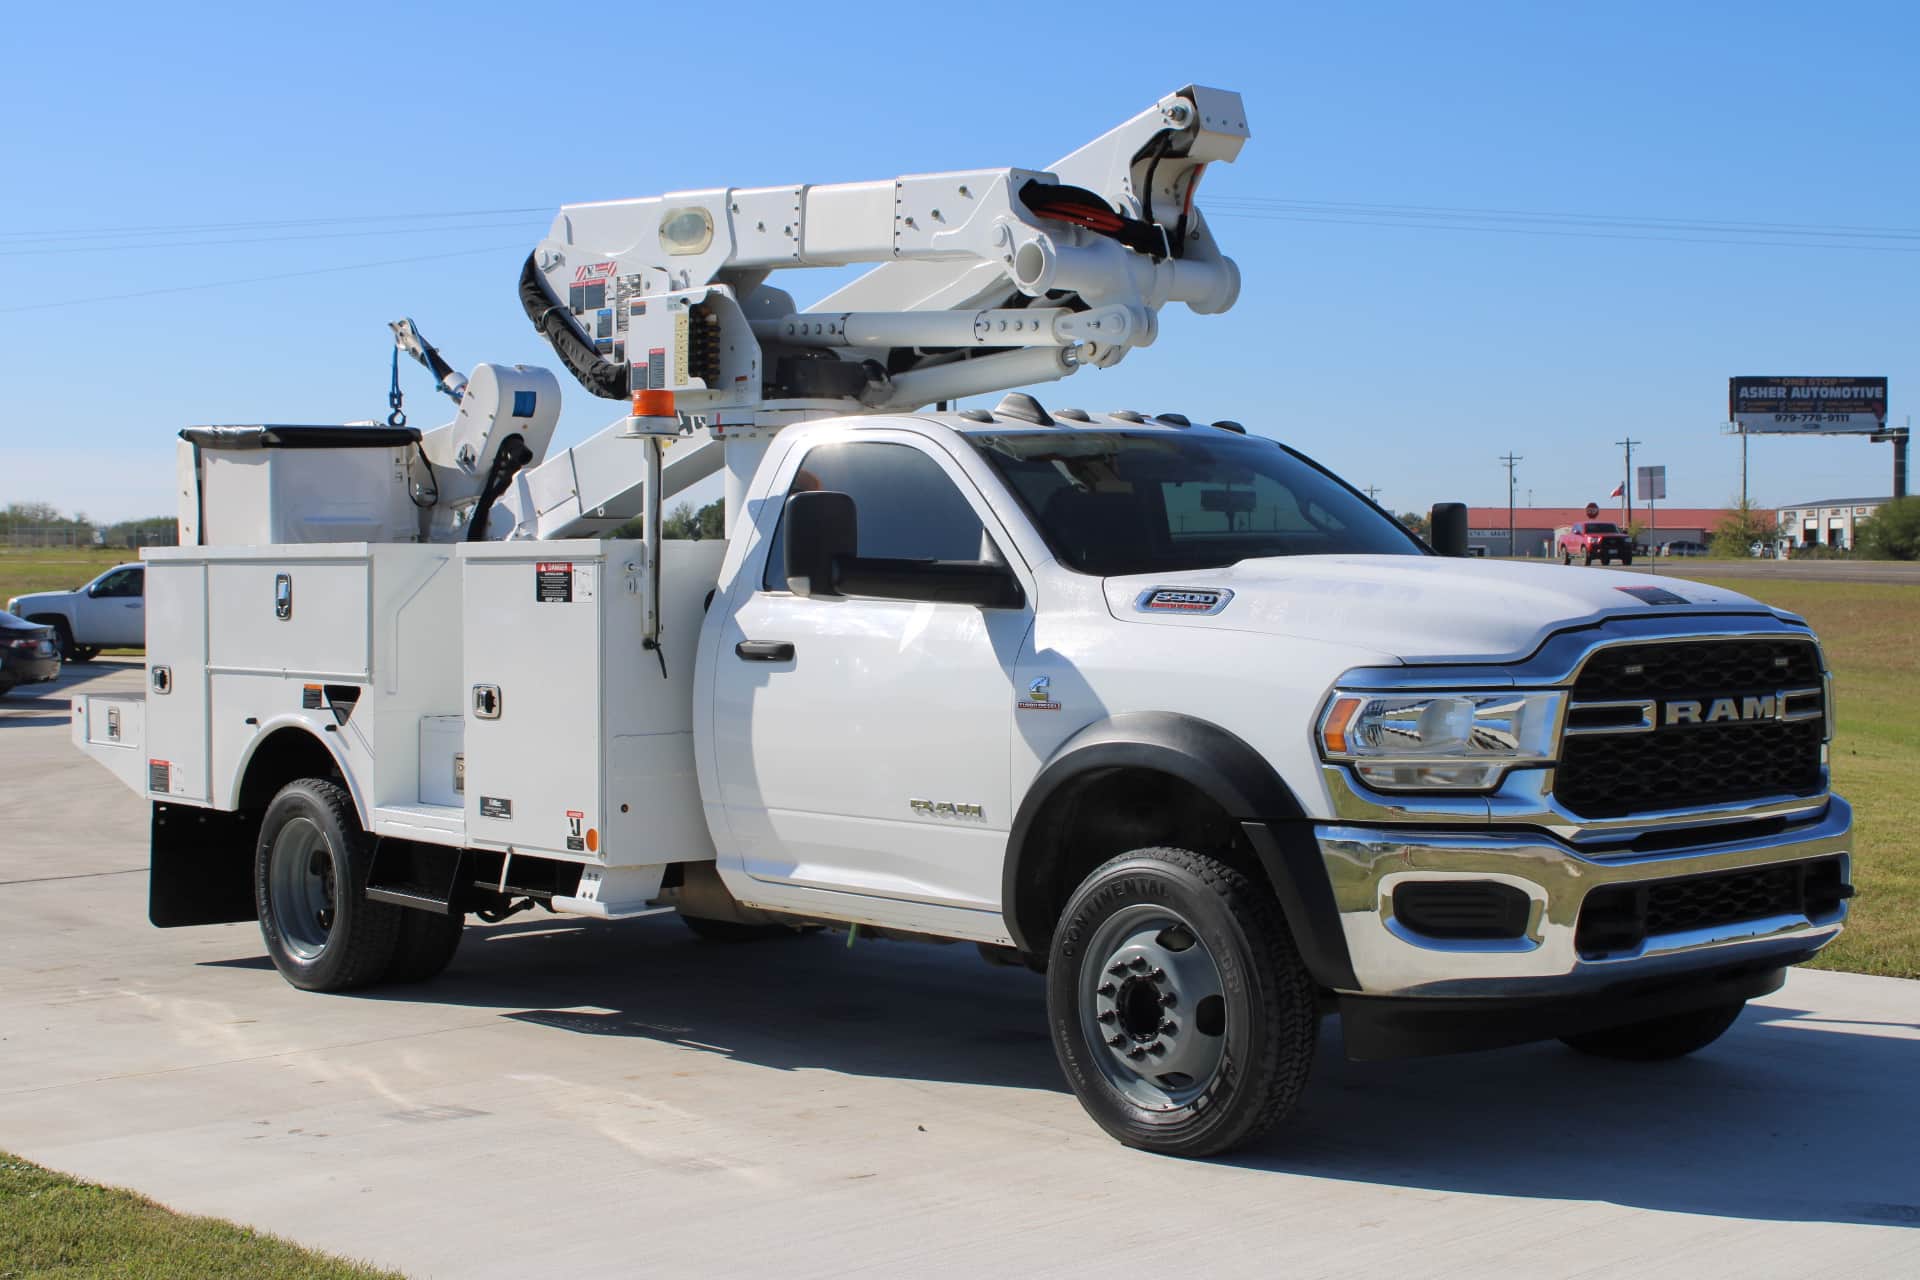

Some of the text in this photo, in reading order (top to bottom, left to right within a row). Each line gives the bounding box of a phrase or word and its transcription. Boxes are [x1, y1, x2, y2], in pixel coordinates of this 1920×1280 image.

[1739, 387, 1883, 398] ASHER AUTOMOTIVE
[1665, 695, 1777, 725] RAM
[910, 799, 983, 816] RAM
